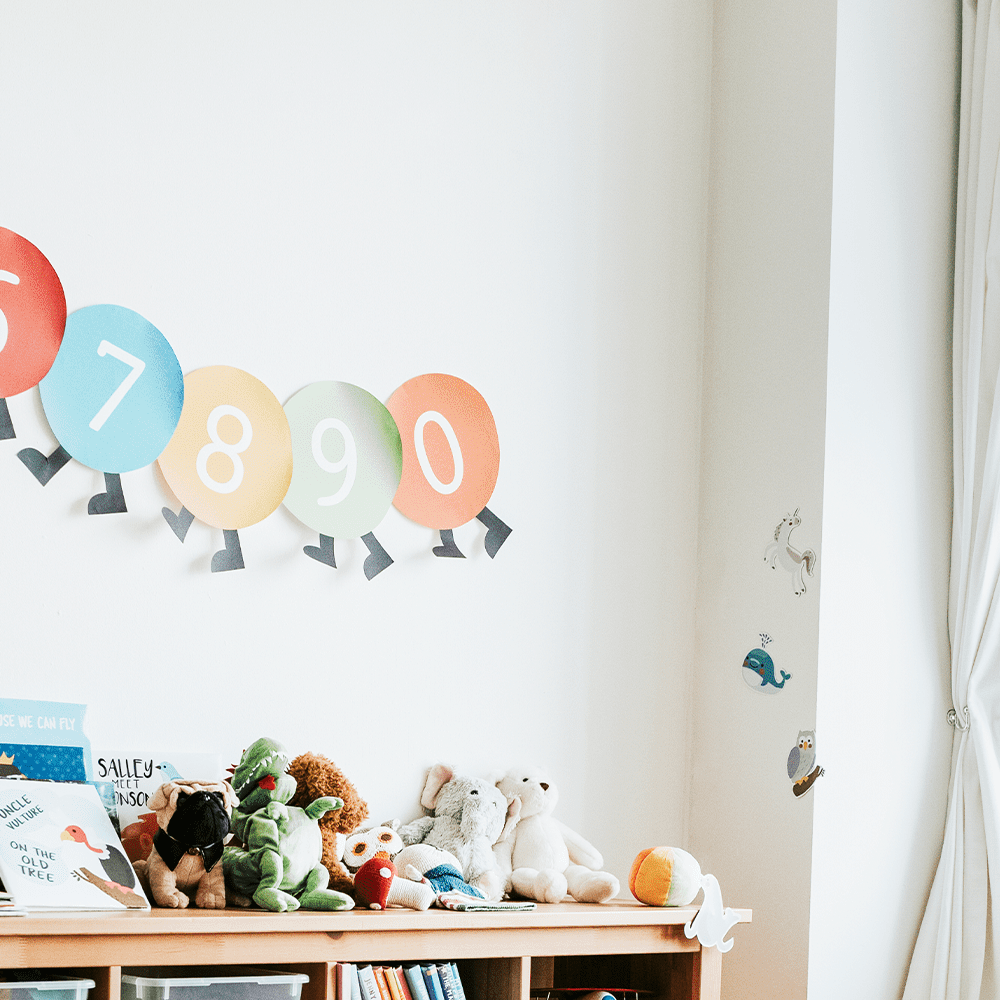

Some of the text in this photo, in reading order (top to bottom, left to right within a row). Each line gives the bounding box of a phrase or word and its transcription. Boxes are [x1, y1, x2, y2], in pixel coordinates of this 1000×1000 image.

[88, 340, 146, 432] 7
[196, 405, 253, 493] 8
[311, 418, 358, 506] 9
[413, 410, 464, 495] 0
[18, 715, 33, 728] WE
[37, 716, 56, 730] CAN
[59, 717, 76, 731] FLY
[98, 758, 153, 778] SALLEY
[112, 779, 139, 788] MEET
[6, 805, 44, 831] VULTURE
[10, 841, 56, 861] ON THE
[21, 856, 48, 869] OLD
[17, 864, 54, 883] TREE
[364, 978, 377, 999] JENNY
